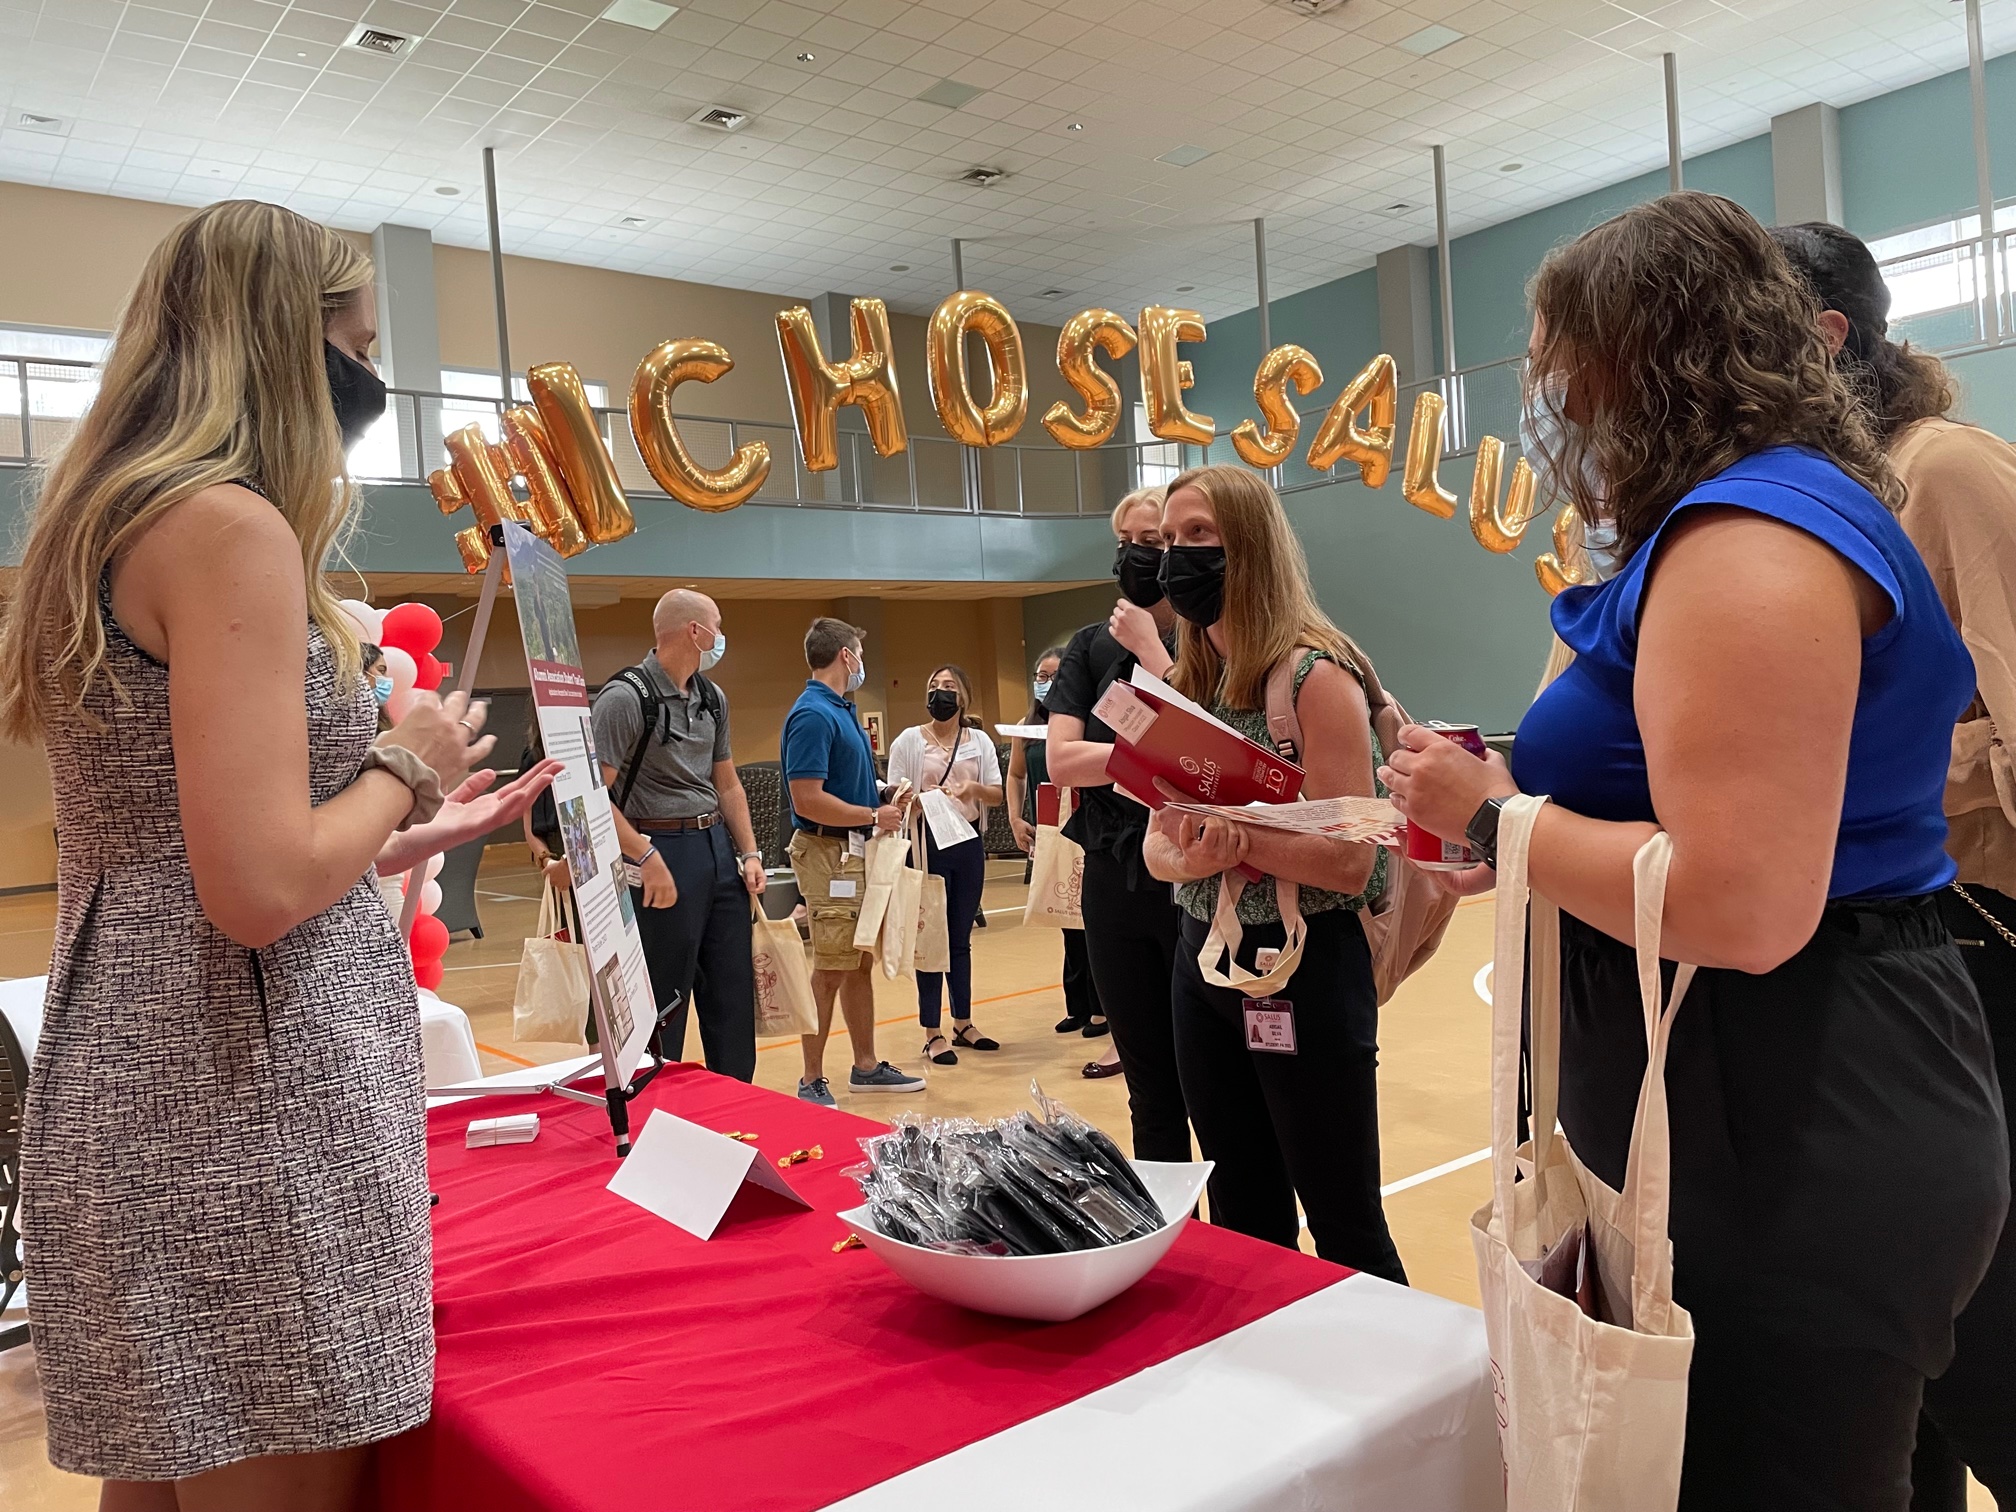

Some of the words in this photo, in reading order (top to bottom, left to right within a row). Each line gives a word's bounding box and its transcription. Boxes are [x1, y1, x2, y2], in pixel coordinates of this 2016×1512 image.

[1198, 757, 1217, 796] SALUS
[1209, 765, 1222, 799] UNIVERSITY
[1265, 768, 1285, 795] 100
[1264, 1013, 1281, 1021] SALUS
